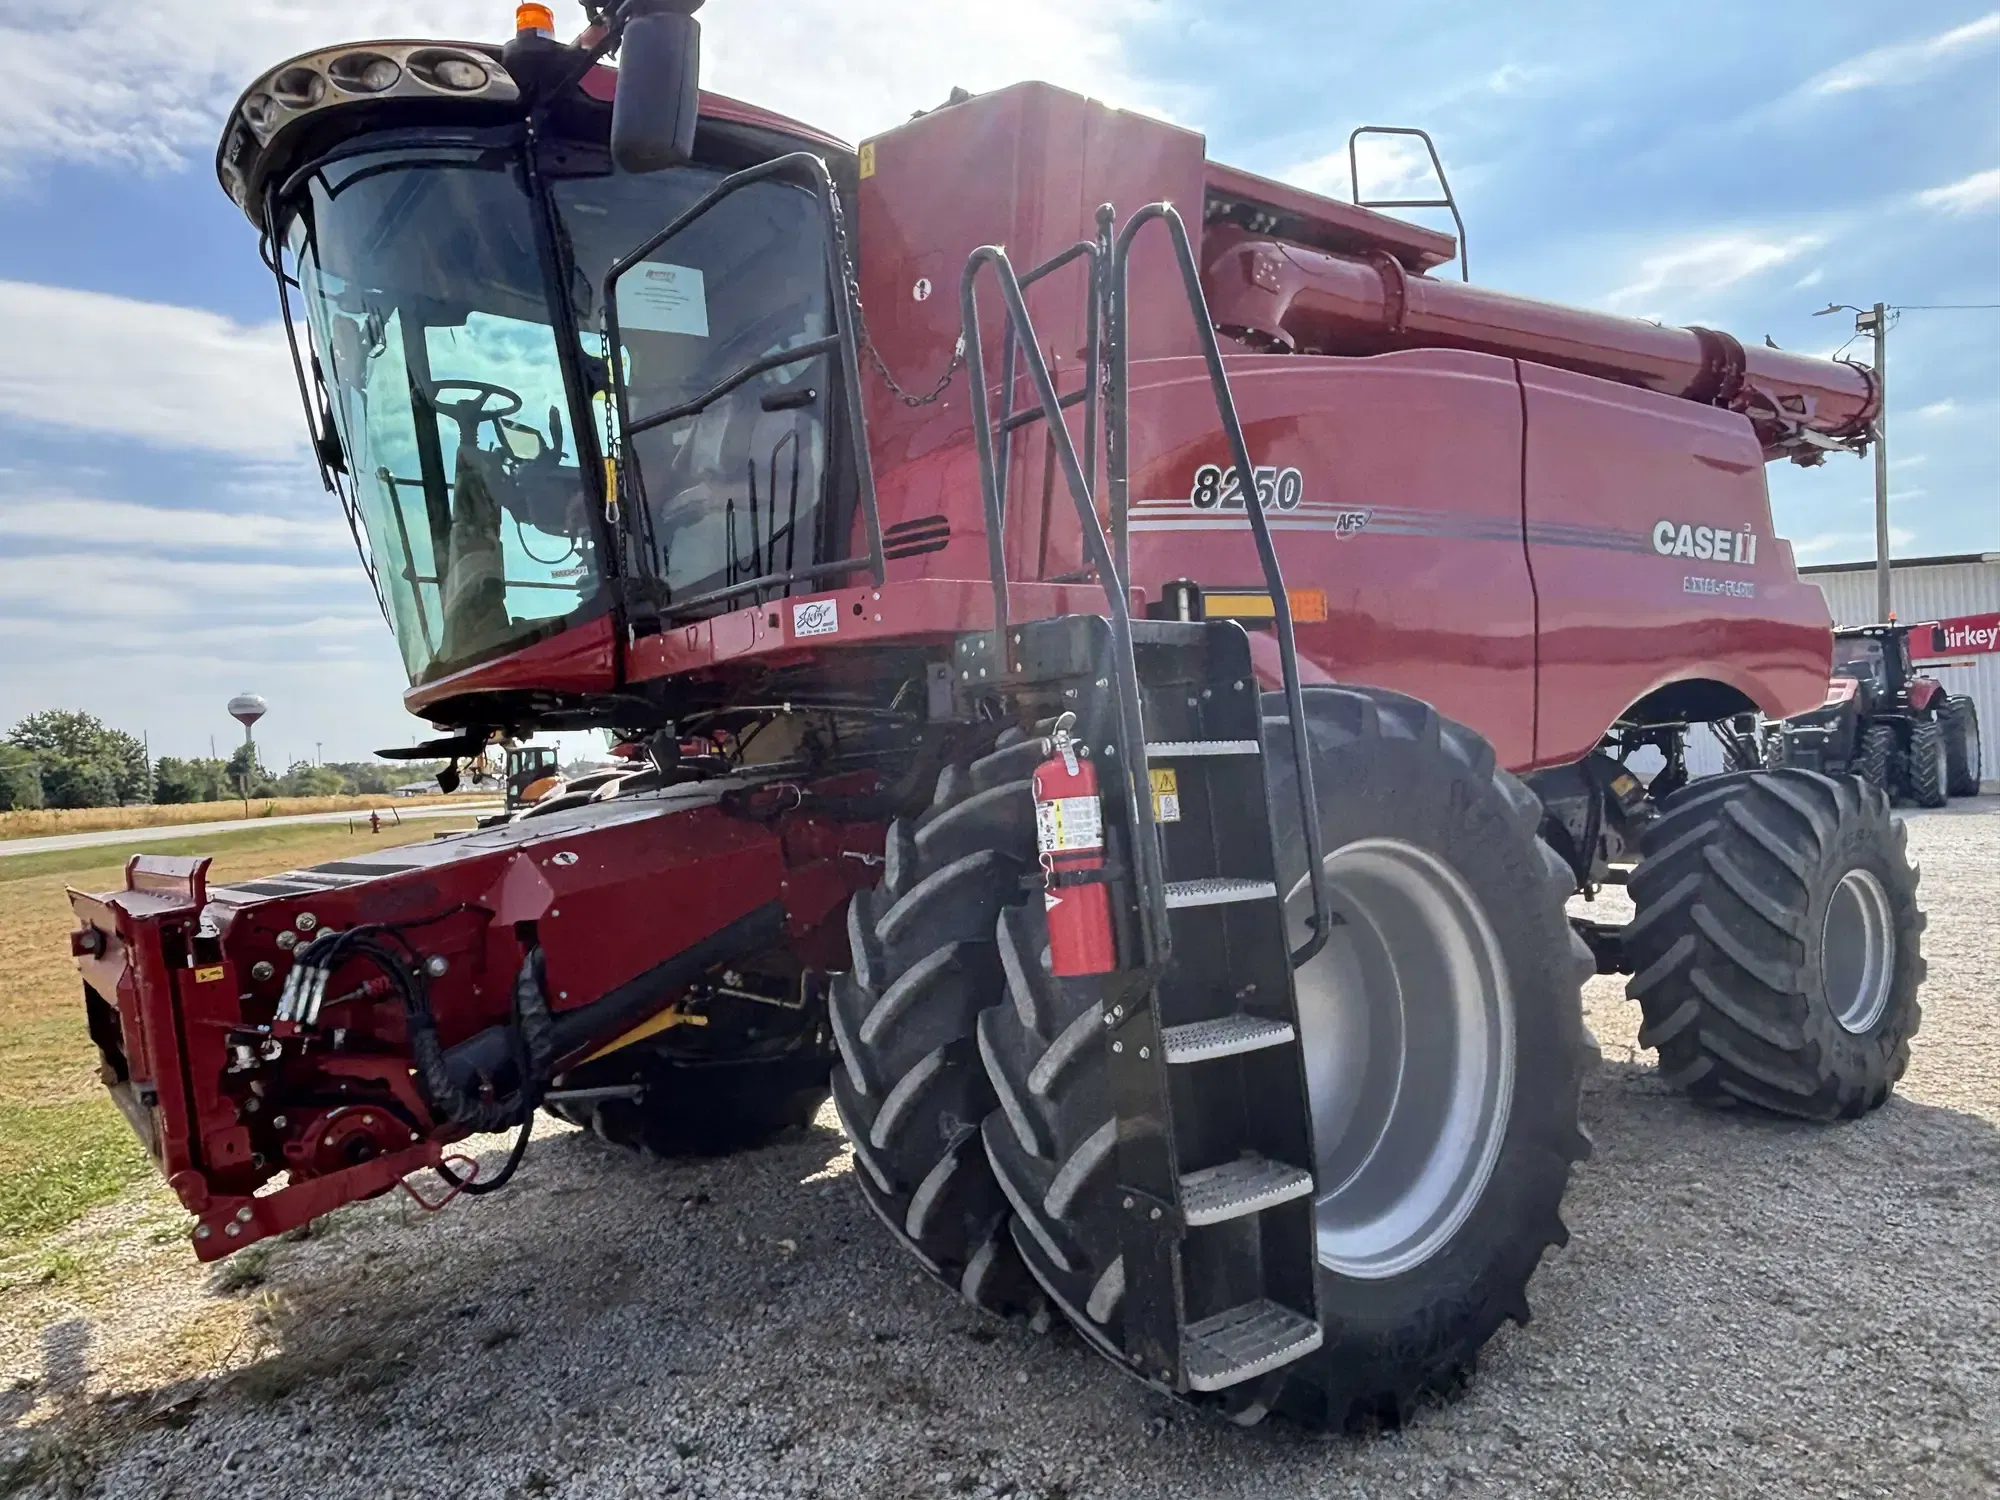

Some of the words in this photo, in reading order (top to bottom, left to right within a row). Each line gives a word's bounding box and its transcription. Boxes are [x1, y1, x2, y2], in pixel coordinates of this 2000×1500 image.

[1190, 464, 1303, 511] 8250
[1336, 512, 1366, 531] AFS
[1653, 520, 1732, 562] CASE
